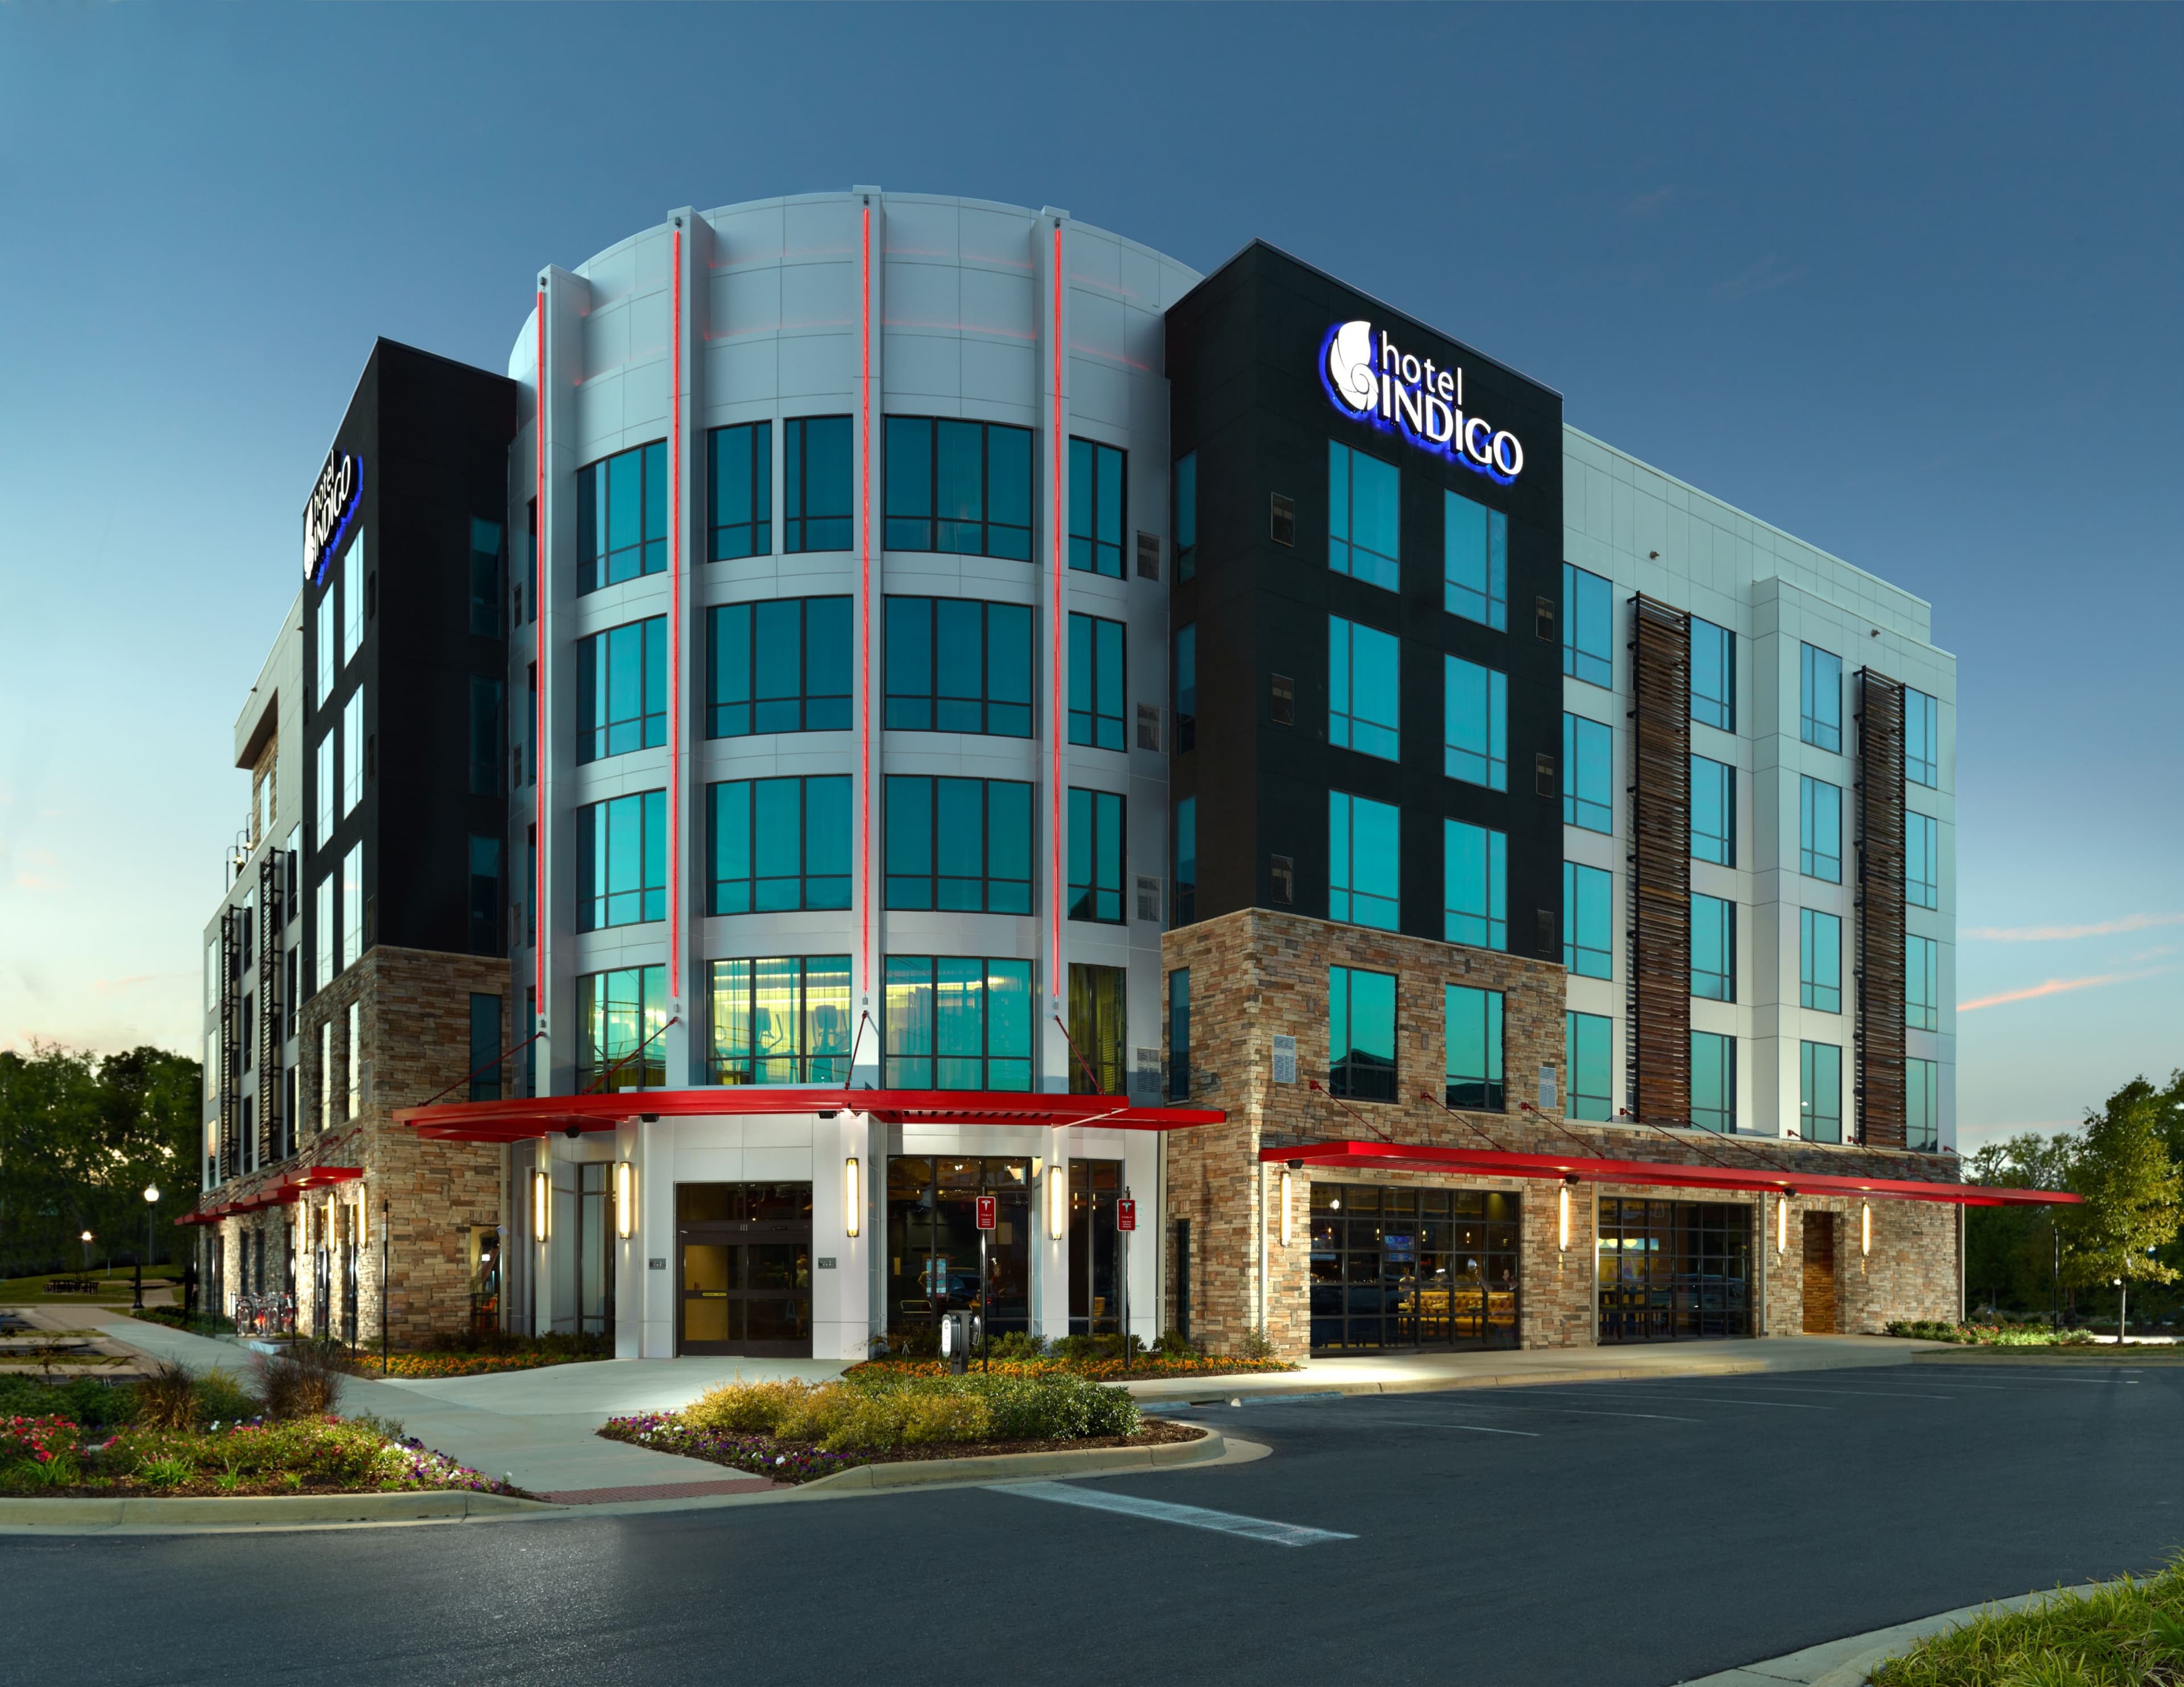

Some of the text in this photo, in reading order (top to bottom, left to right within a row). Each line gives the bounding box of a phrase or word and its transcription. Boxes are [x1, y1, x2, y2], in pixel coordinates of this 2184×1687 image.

[1382, 330, 1462, 405] hotel
[1383, 374, 1524, 475] INDIGO
[314, 449, 334, 521] hotel
[314, 455, 351, 562] INDIGO
